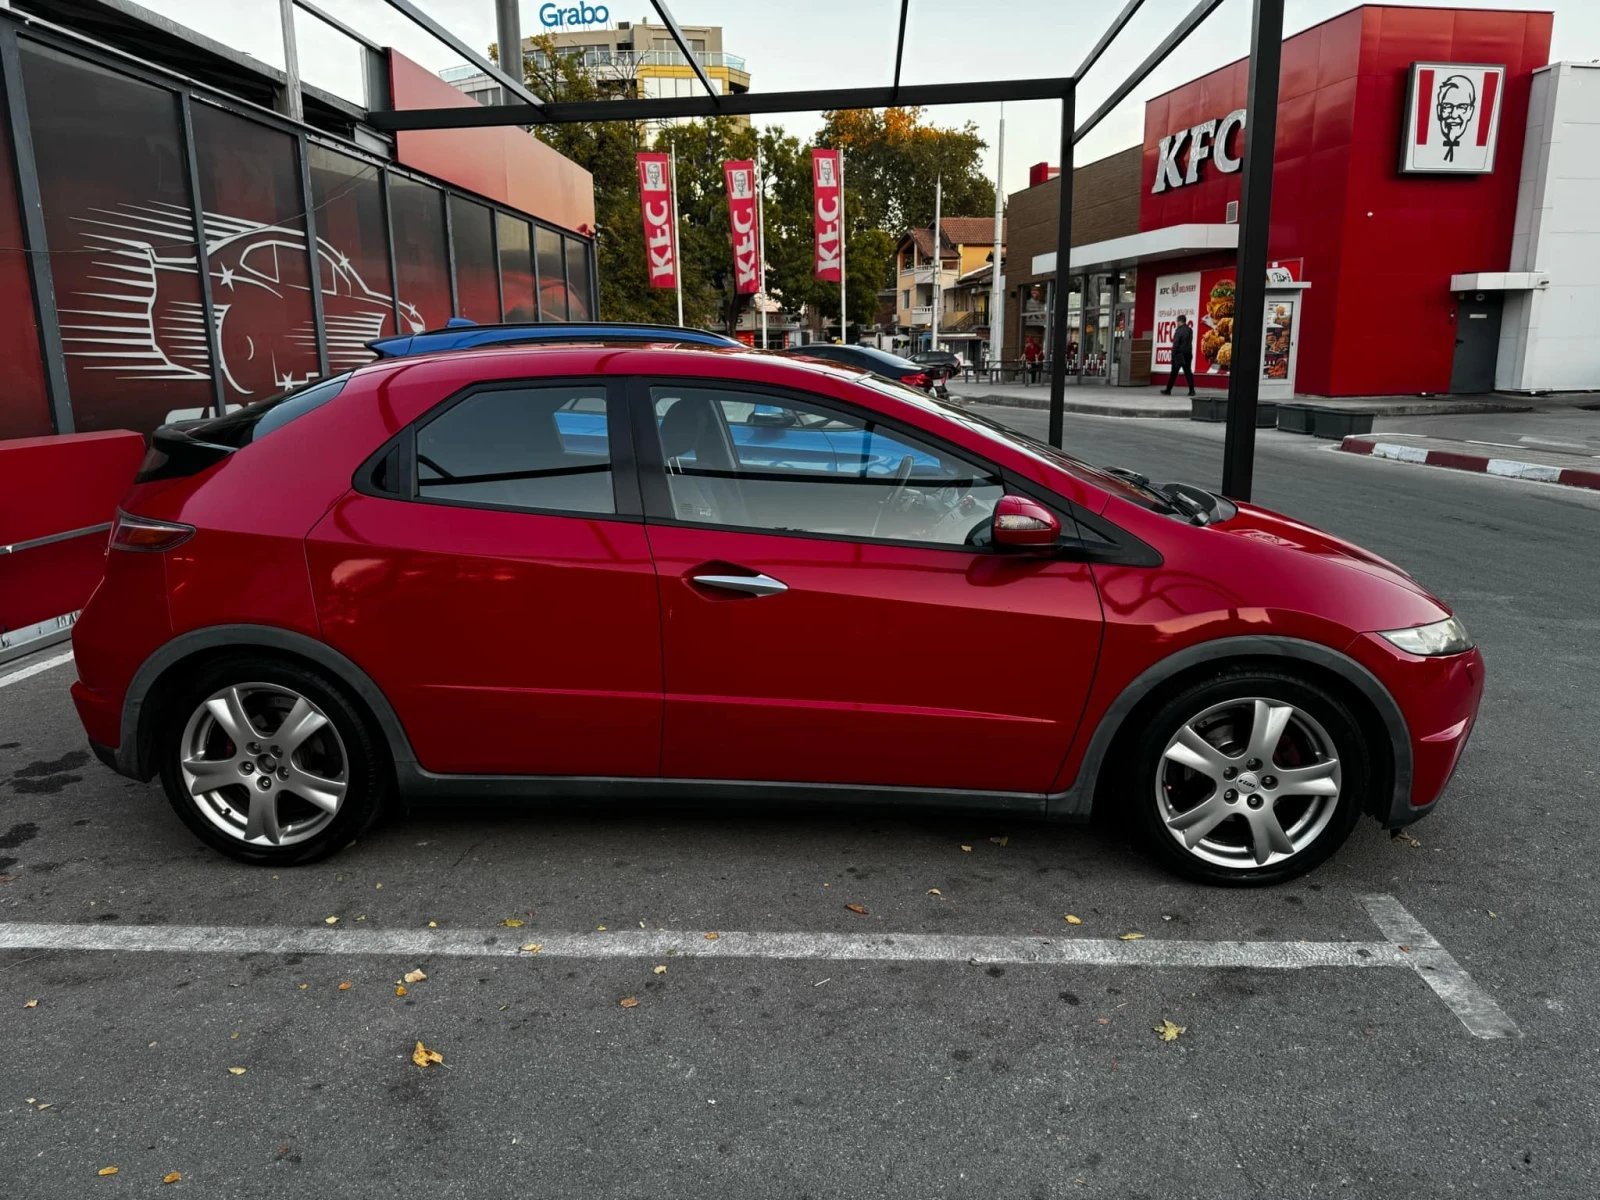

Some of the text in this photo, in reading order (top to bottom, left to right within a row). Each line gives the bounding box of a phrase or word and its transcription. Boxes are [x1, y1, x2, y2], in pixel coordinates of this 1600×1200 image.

[539, 1, 609, 27] Grabo
[1151, 108, 1247, 194] KFC
[646, 201, 673, 279] KFC
[733, 207, 756, 287] KFC
[817, 196, 841, 273] KFC
